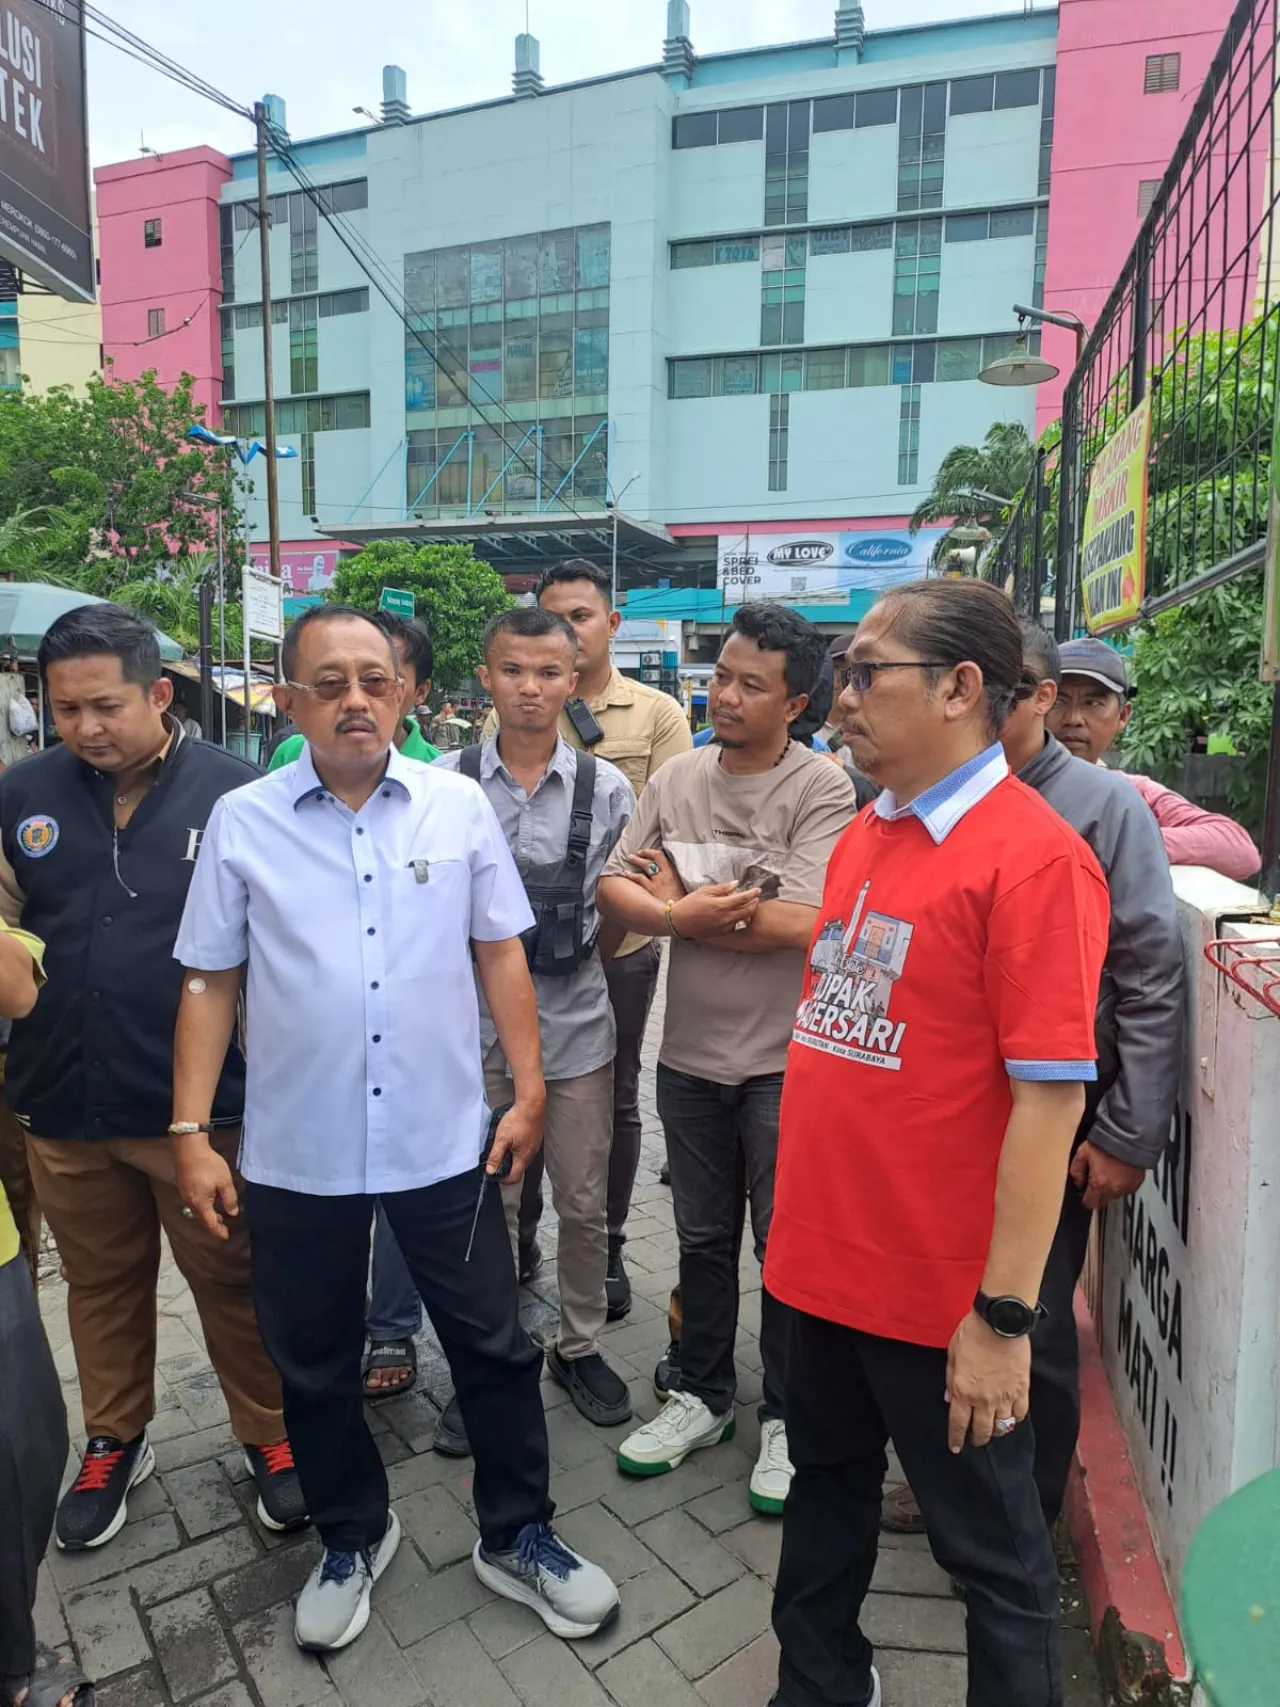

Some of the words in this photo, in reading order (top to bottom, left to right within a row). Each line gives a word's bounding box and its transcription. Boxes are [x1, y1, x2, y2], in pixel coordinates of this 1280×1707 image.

[773, 548, 791, 559] MY
[795, 547, 827, 559] LOVE
[848, 542, 908, 559] California
[723, 556, 759, 566] SPREI
[723, 576, 762, 585] COVER
[847, 1048, 886, 1065] SURABAYA
[1123, 1192, 1183, 1385] HARGA
[1118, 1278, 1158, 1451] MATI
